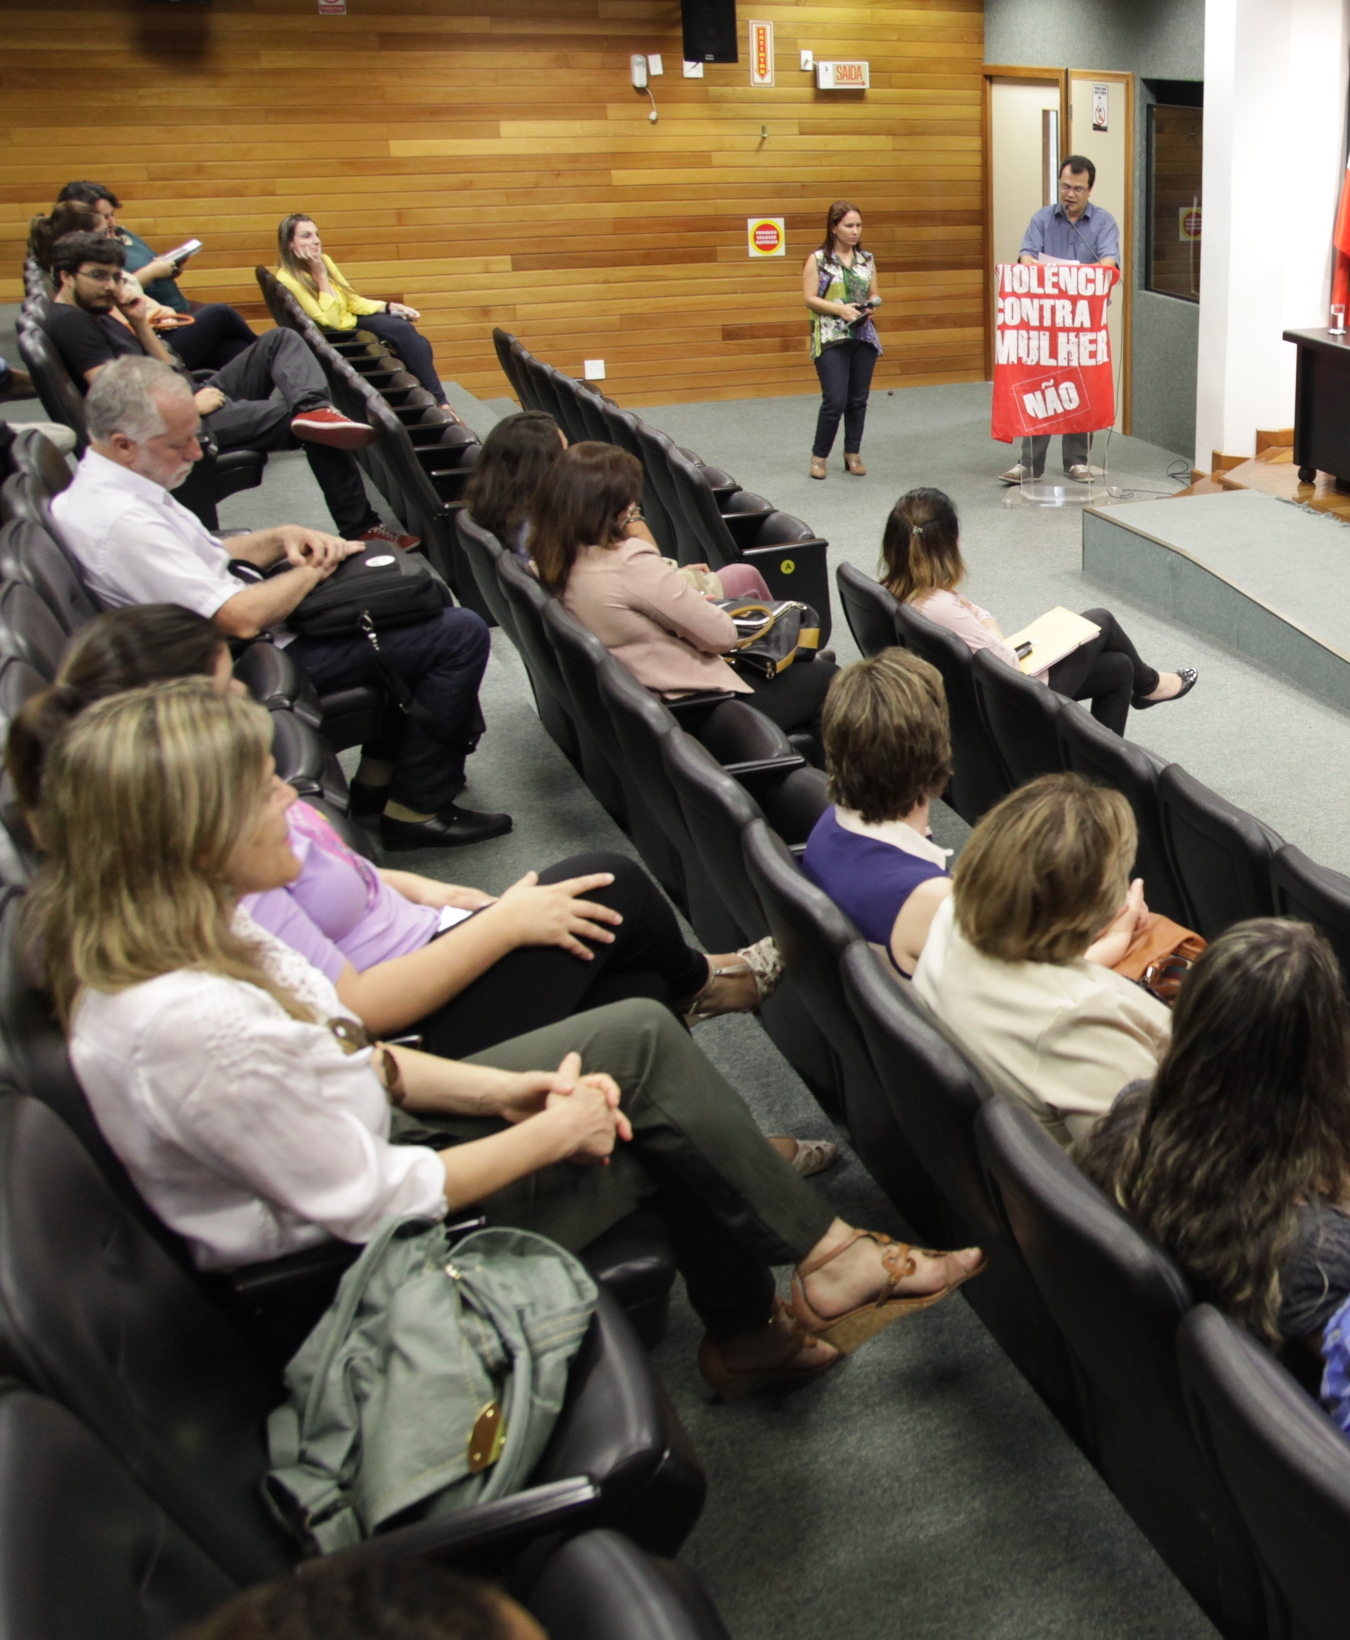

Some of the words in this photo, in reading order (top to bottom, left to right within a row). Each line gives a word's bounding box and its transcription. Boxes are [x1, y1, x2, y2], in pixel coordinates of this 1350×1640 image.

[758, 28, 766, 75] EXTINTOR
[997, 297, 1091, 328] CONTRA
[995, 329, 1110, 367] MULHER
[1022, 379, 1080, 419] NÃO
